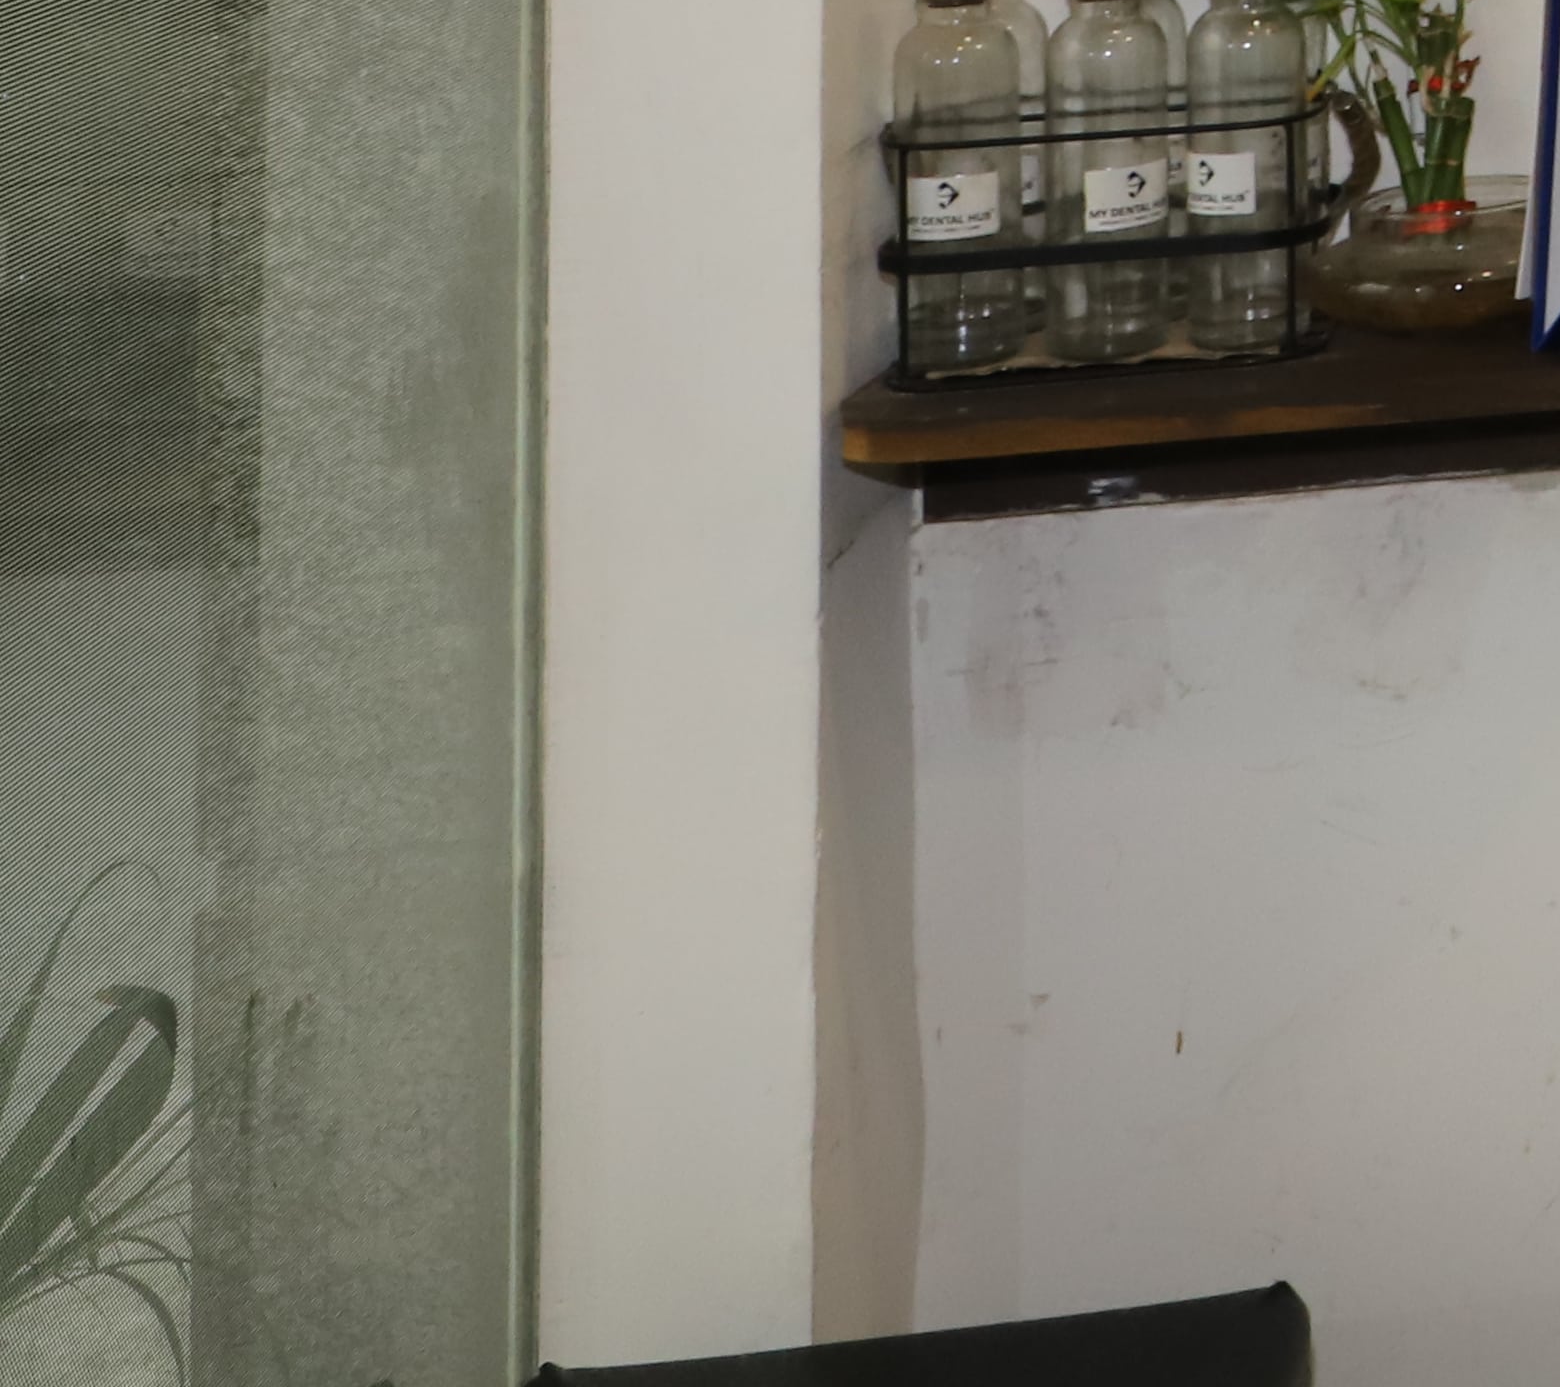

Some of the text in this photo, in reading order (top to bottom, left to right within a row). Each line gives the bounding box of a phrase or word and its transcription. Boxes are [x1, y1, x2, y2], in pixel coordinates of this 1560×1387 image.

[1221, 193, 1246, 203] HUB
[921, 211, 991, 226] DENTAL HUB
[1089, 207, 1107, 219] MY
[1110, 203, 1150, 217] DENTAL
